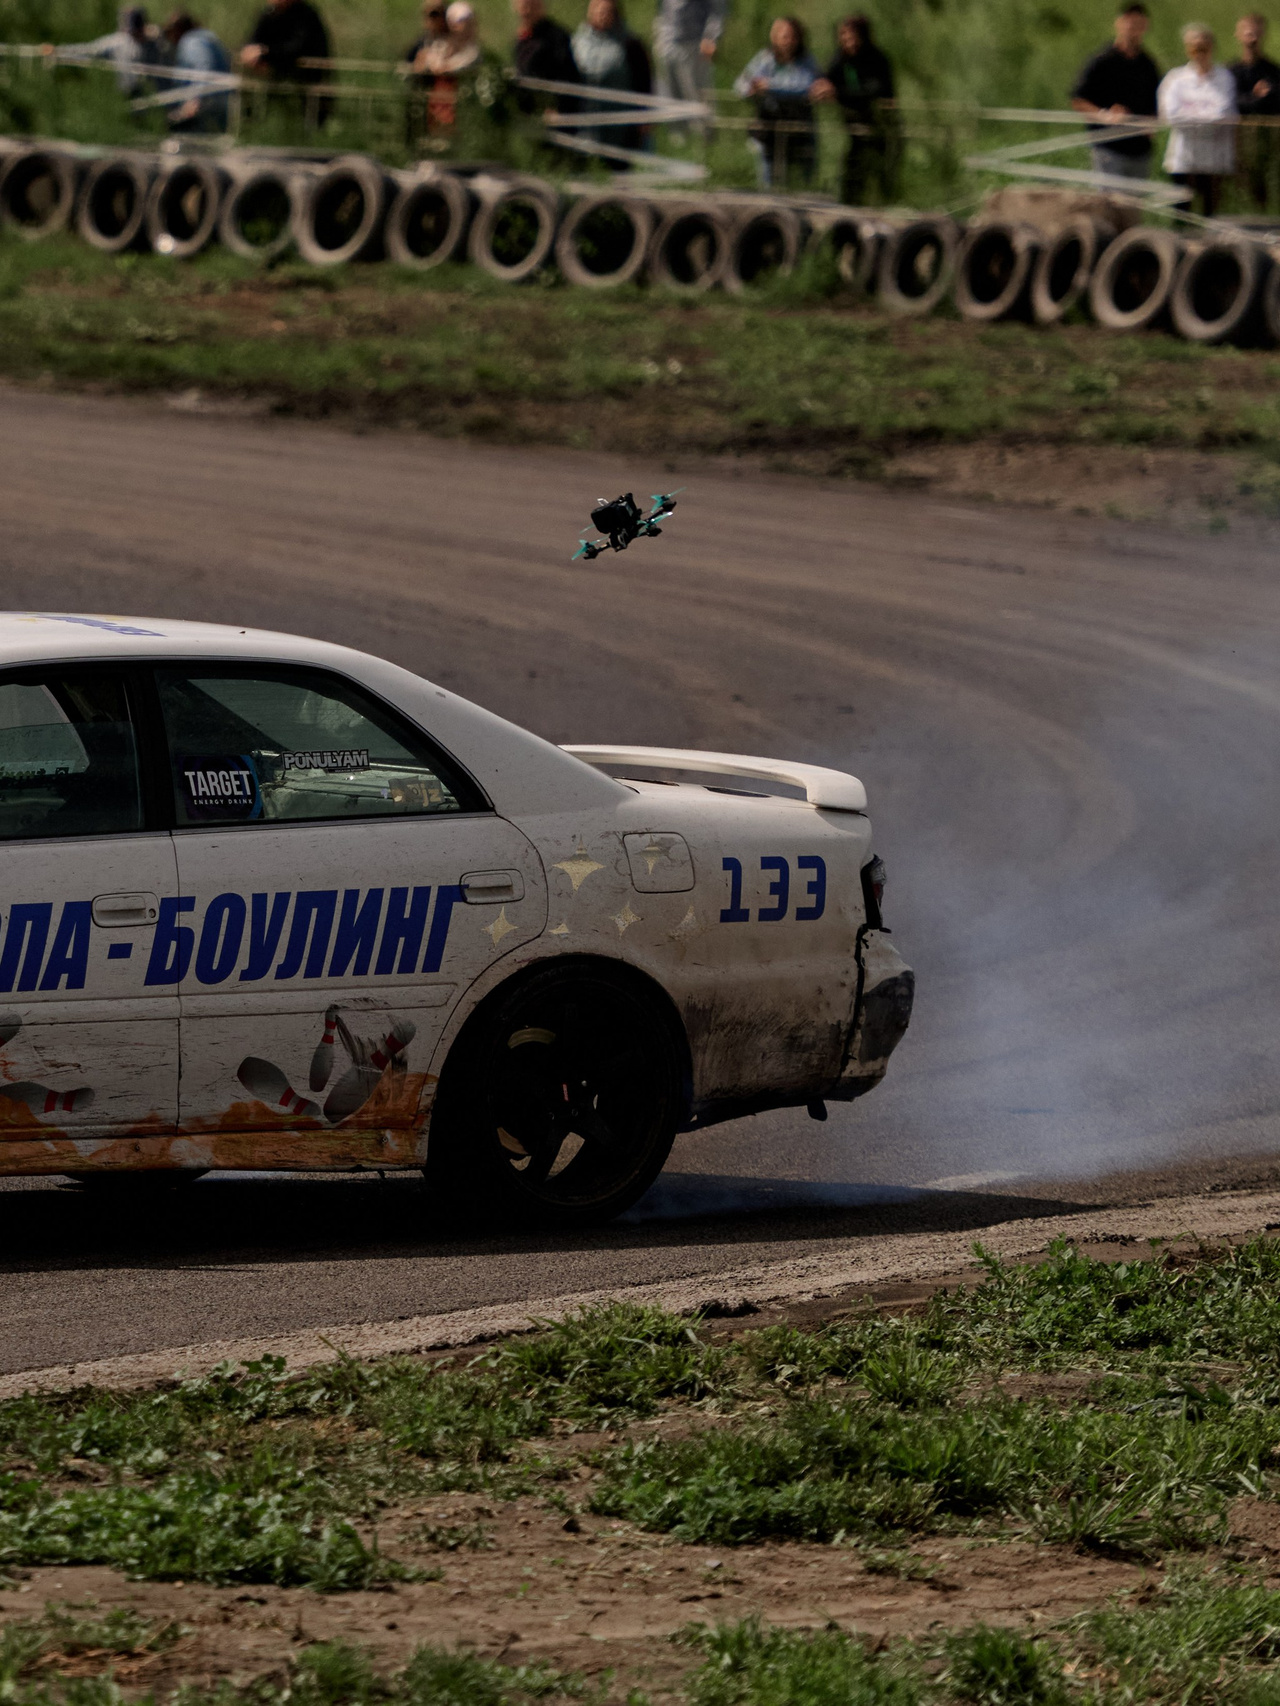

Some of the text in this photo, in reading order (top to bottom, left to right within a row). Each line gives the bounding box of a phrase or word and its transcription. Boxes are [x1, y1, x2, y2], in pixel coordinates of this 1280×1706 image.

[184, 770, 251, 796] TARGET
[282, 750, 369, 769] PONULYAM
[720, 855, 826, 923] 133
[143, 884, 470, 986] БОУЛИНГ
